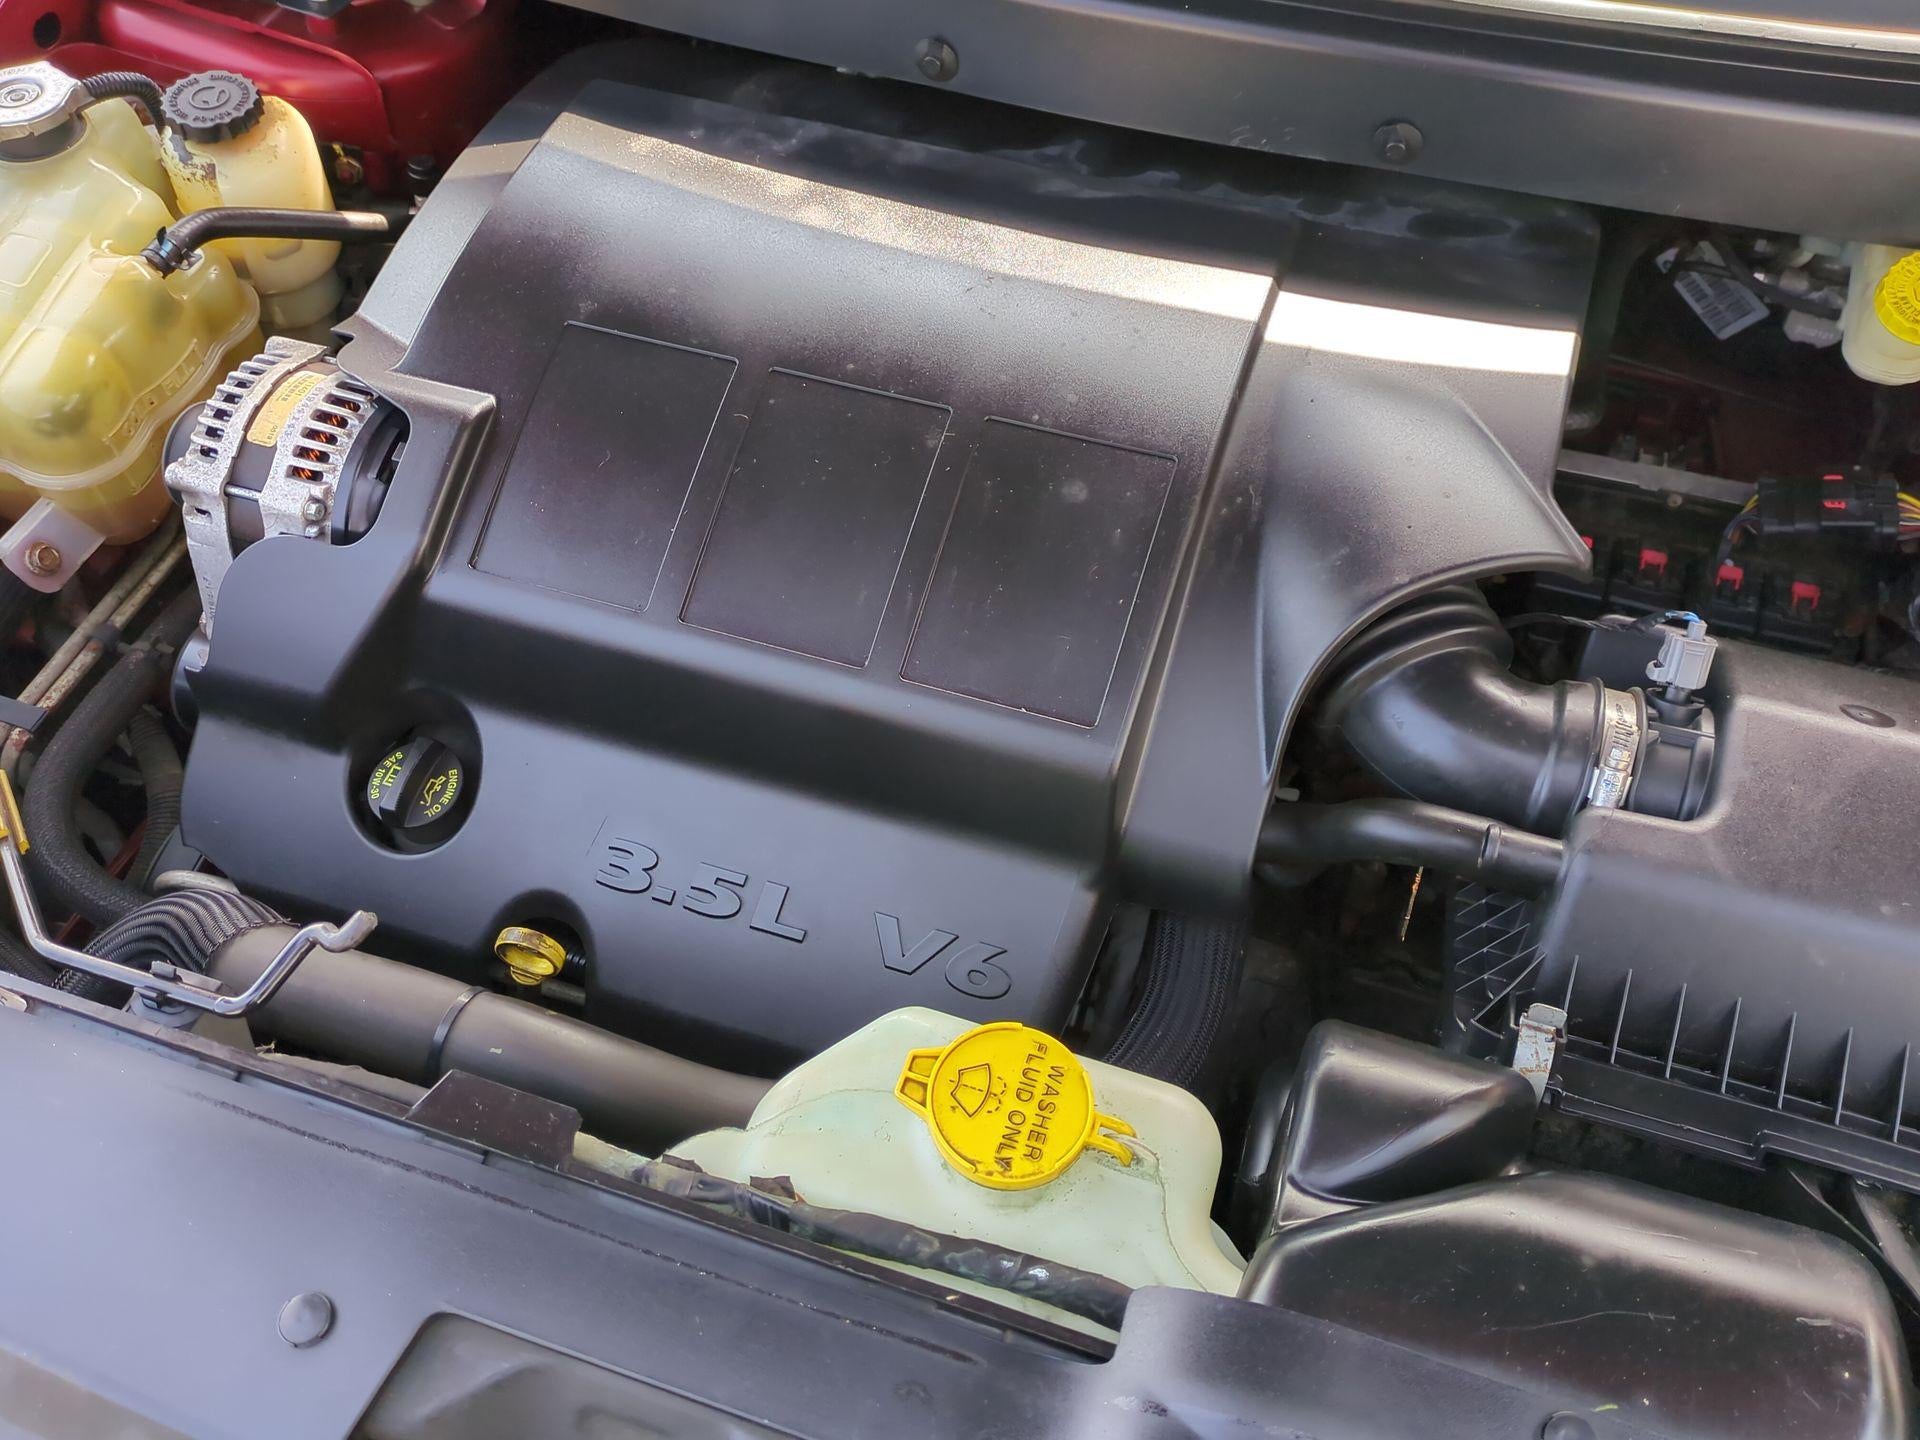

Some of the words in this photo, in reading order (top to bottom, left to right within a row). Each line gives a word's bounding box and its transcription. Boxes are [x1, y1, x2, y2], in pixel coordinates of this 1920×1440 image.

[370, 768, 385, 800] 10W-30
[383, 751, 403, 768] SAE
[424, 804, 442, 818] OIL
[440, 768, 458, 805] ENGINE
[596, 837, 807, 943] 3.5L
[874, 911, 1012, 1000] V6
[1015, 1039, 1049, 1103] FLUID
[1023, 1065, 1067, 1162] WASHER
[994, 1110, 1027, 1172] ONLY
